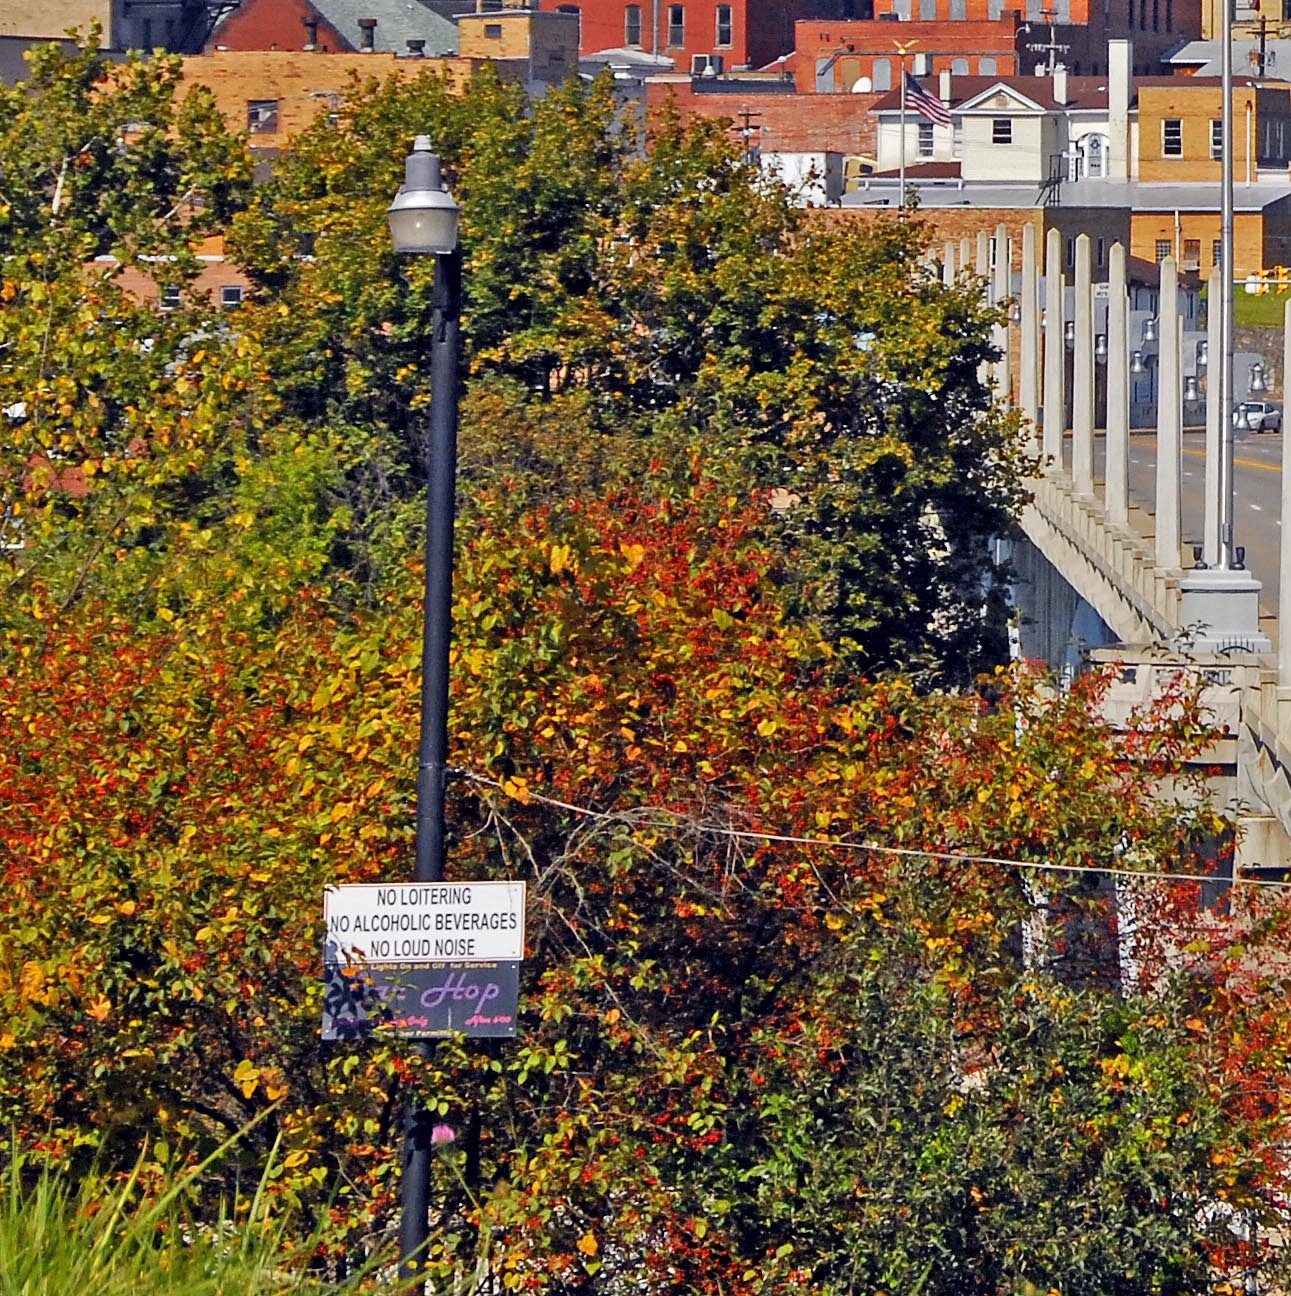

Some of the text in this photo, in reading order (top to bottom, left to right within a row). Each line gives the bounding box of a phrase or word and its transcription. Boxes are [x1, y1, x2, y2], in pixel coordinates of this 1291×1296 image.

[377, 887, 472, 906] NO LOITERING
[330, 912, 517, 933] NO ALCOHOLIC BEVERAGES
[371, 938, 475, 957] NO LOUD NOISE
[420, 972, 500, 1014] Hop
